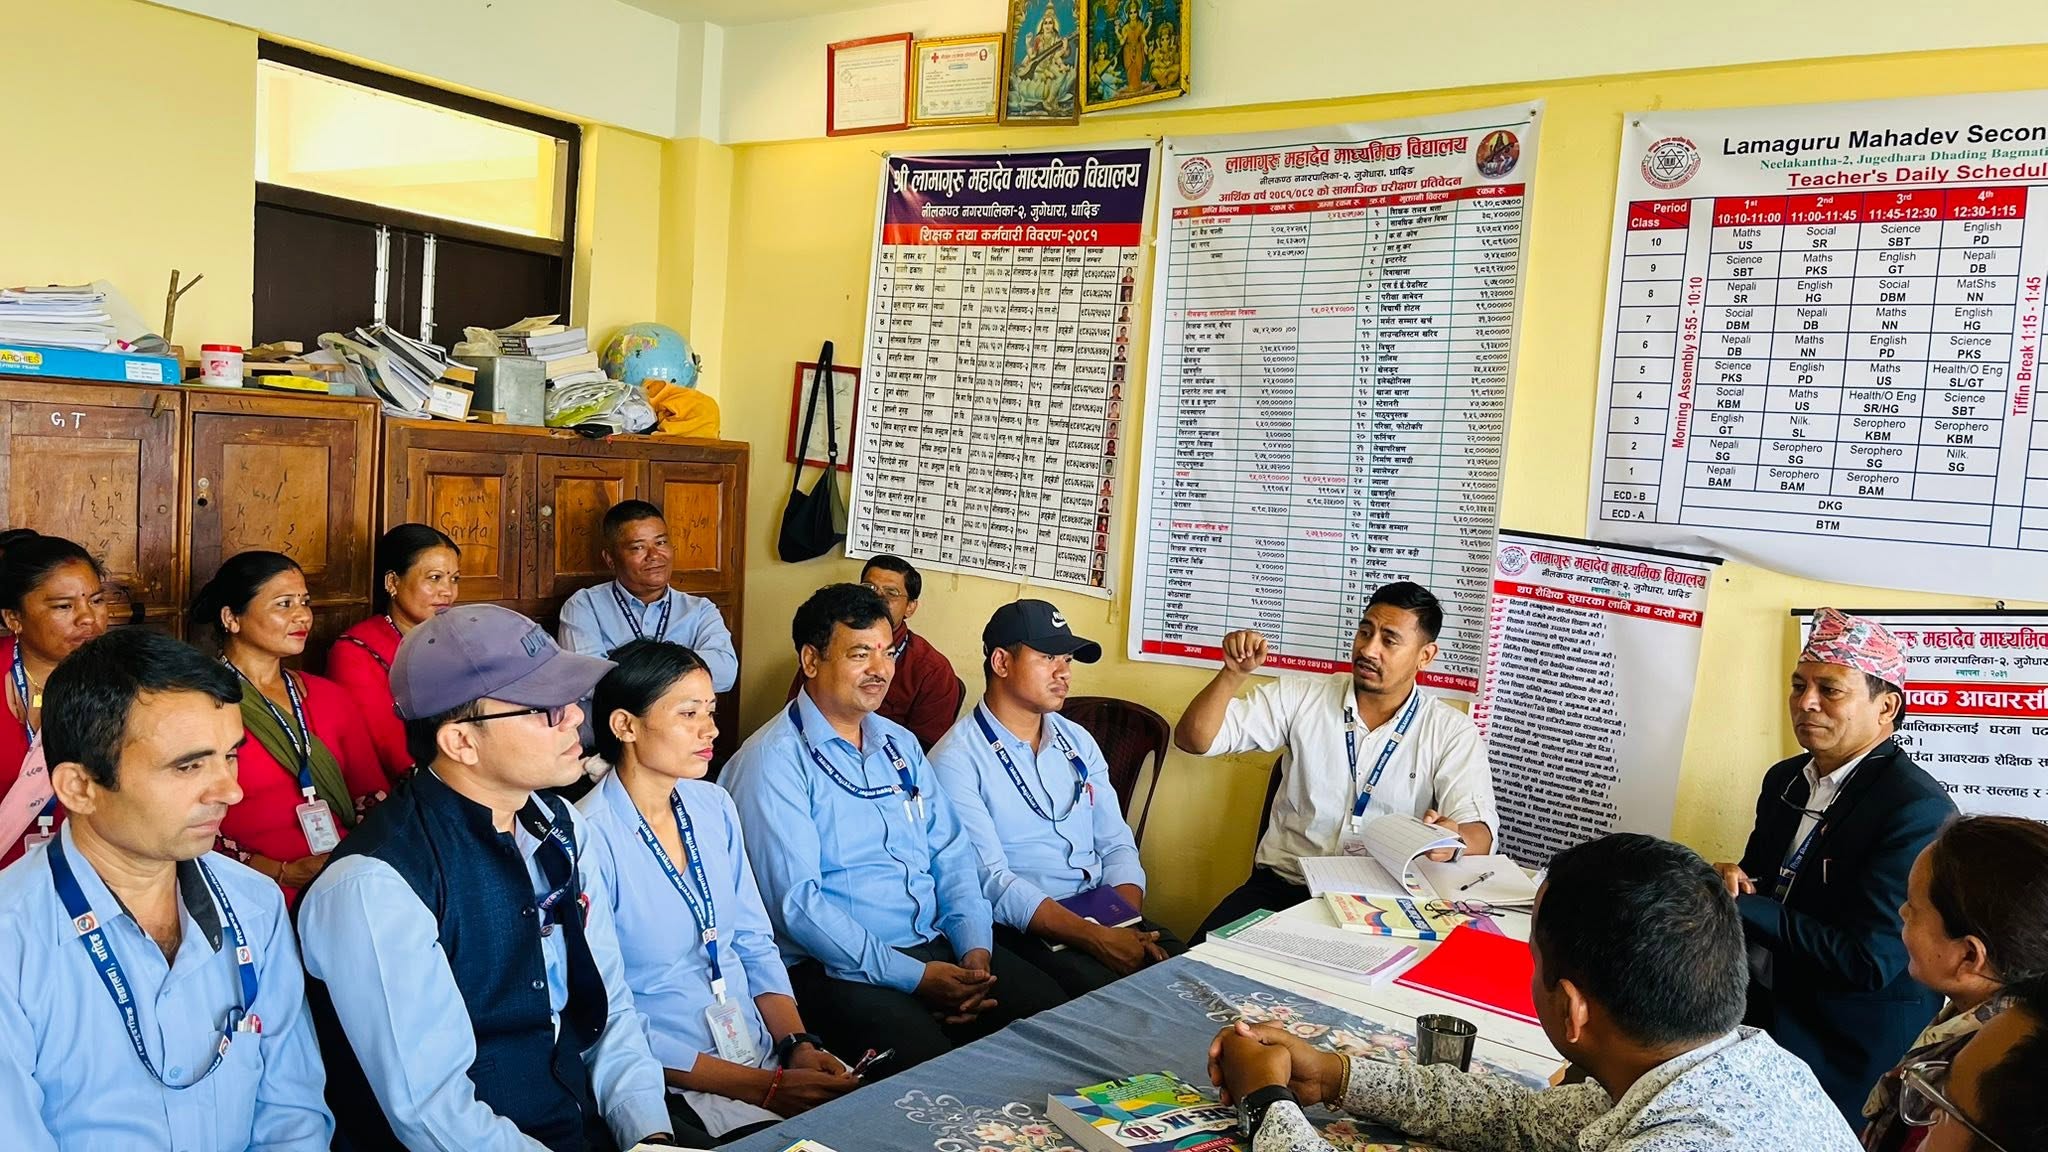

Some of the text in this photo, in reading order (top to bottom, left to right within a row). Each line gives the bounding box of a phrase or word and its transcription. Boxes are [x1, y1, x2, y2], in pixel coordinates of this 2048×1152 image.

[1723, 136, 1840, 156] Lamaguru
[1849, 127, 1959, 149] Mahadev
[1225, 136, 1469, 174] लामागुरु महादेव माध्यमिक विद्यालय
[1760, 147, 2048, 170] Neelakantha-2, Jugedhara Dhading Bagmati
[893, 163, 910, 193] श्री
[911, 169, 966, 198] लामागुरु
[967, 160, 1014, 193] महादेव
[1015, 157, 1082, 190] माध्यमिक
[1083, 156, 1142, 189] विद्यालय
[1788, 168, 1888, 187] Teacher's
[1896, 166, 1949, 184] Daily
[1218, 190, 1251, 203] आर्थिक
[1254, 188, 1267, 201] वर्ष
[1317, 184, 1329, 197] को
[1332, 181, 1378, 196] सामाजिक
[1381, 179, 1417, 193] परीक्षण
[1420, 176, 1463, 190] प्रतिवेदन
[1896, 193, 1912, 205] 3rd
[1977, 190, 1994, 202] 4th
[1744, 199, 1758, 210] 1st
[1816, 196, 1834, 208] 2nd
[921, 201, 961, 218] नीलकण्ठ
[1071, 200, 1101, 219] धादिङ
[1653, 203, 1687, 213] Period
[1953, 205, 2017, 218] 12:30-1:15
[1717, 212, 1781, 224] 10:10-11:00
[1790, 210, 1857, 223] 11:00-11:45
[1868, 208, 1937, 220] 11:45-12:30
[1631, 217, 1660, 228] Class
[1964, 222, 2002, 233] English
[920, 225, 1098, 244] शिक्षक तथा कर्मचारी विवरण-२०८१
[1732, 228, 1761, 237] Maths
[1806, 226, 1836, 236] Social
[1880, 224, 1921, 234] Science
[1650, 238, 1662, 247] 10
[1738, 241, 1753, 250] US
[1812, 239, 1828, 248] SR
[1888, 237, 1911, 247] SBT
[1973, 235, 1990, 245] PD
[1726, 255, 1763, 265] Science
[1803, 253, 1833, 263] Maths
[1878, 251, 1917, 263] English
[1963, 250, 1997, 261] Nepali
[1650, 263, 1657, 272] 9
[1733, 268, 1754, 277] SBT
[1805, 266, 1828, 275] PKS
[1888, 265, 1904, 274] GT
[1970, 263, 1987, 273] DB
[1727, 282, 1757, 292] Nepali
[1797, 280, 1833, 292] English
[1878, 280, 1910, 289] Social
[1957, 279, 1996, 289] MatShs
[1648, 289, 1654, 298] 8
[1733, 294, 1748, 303] SR
[1805, 293, 1822, 302] HG
[1880, 293, 1906, 302] DBM
[1967, 292, 1984, 301] NN
[1725, 308, 1754, 318] Social
[1797, 308, 1828, 319] Nepali
[1875, 307, 1907, 317] Maths
[1954, 307, 1993, 318] English
[1645, 315, 1651, 324] 7
[1726, 321, 1750, 330] DBM
[1803, 321, 1819, 330] DB
[1881, 321, 1899, 330] NN
[1964, 321, 1981, 330] HG
[2012, 277, 2041, 416] Tiffin Break 1:15 1:45
[1, 353, 40, 364] ARCHIES
[1672, 277, 1703, 448] Morning Assembly 9:55 10:10
[1706, 465, 1736, 476] Nepali
[1769, 468, 1820, 480] Serophero
[1708, 477, 1731, 488] BAM
[1847, 471, 1900, 484] Serophero
[1780, 482, 1805, 492] BAM
[1858, 486, 1884, 496] BAM
[1613, 491, 1646, 501] ECD B
[1818, 501, 1843, 511] DKG
[1612, 509, 1645, 520] ECD A
[1816, 520, 1840, 530] BTM
[1530, 550, 1573, 571] लामागुरु
[1574, 555, 1609, 574] महादेव
[1611, 562, 1662, 583] माध्यमिक
[1663, 567, 1707, 589] विद्यालय
[1567, 590, 1605, 607] सुधारका
[1607, 599, 1631, 612] लागि
[1633, 603, 1650, 614] अब
[1653, 605, 1675, 618] यसो
[1505, 625, 1549, 640] Mobile Learning
[1922, 627, 1976, 650] महादेव
[1990, 725, 2021, 736] घरमा
[1938, 753, 1989, 764] आवश्यक
[88, 933, 109, 962] धादिङ
